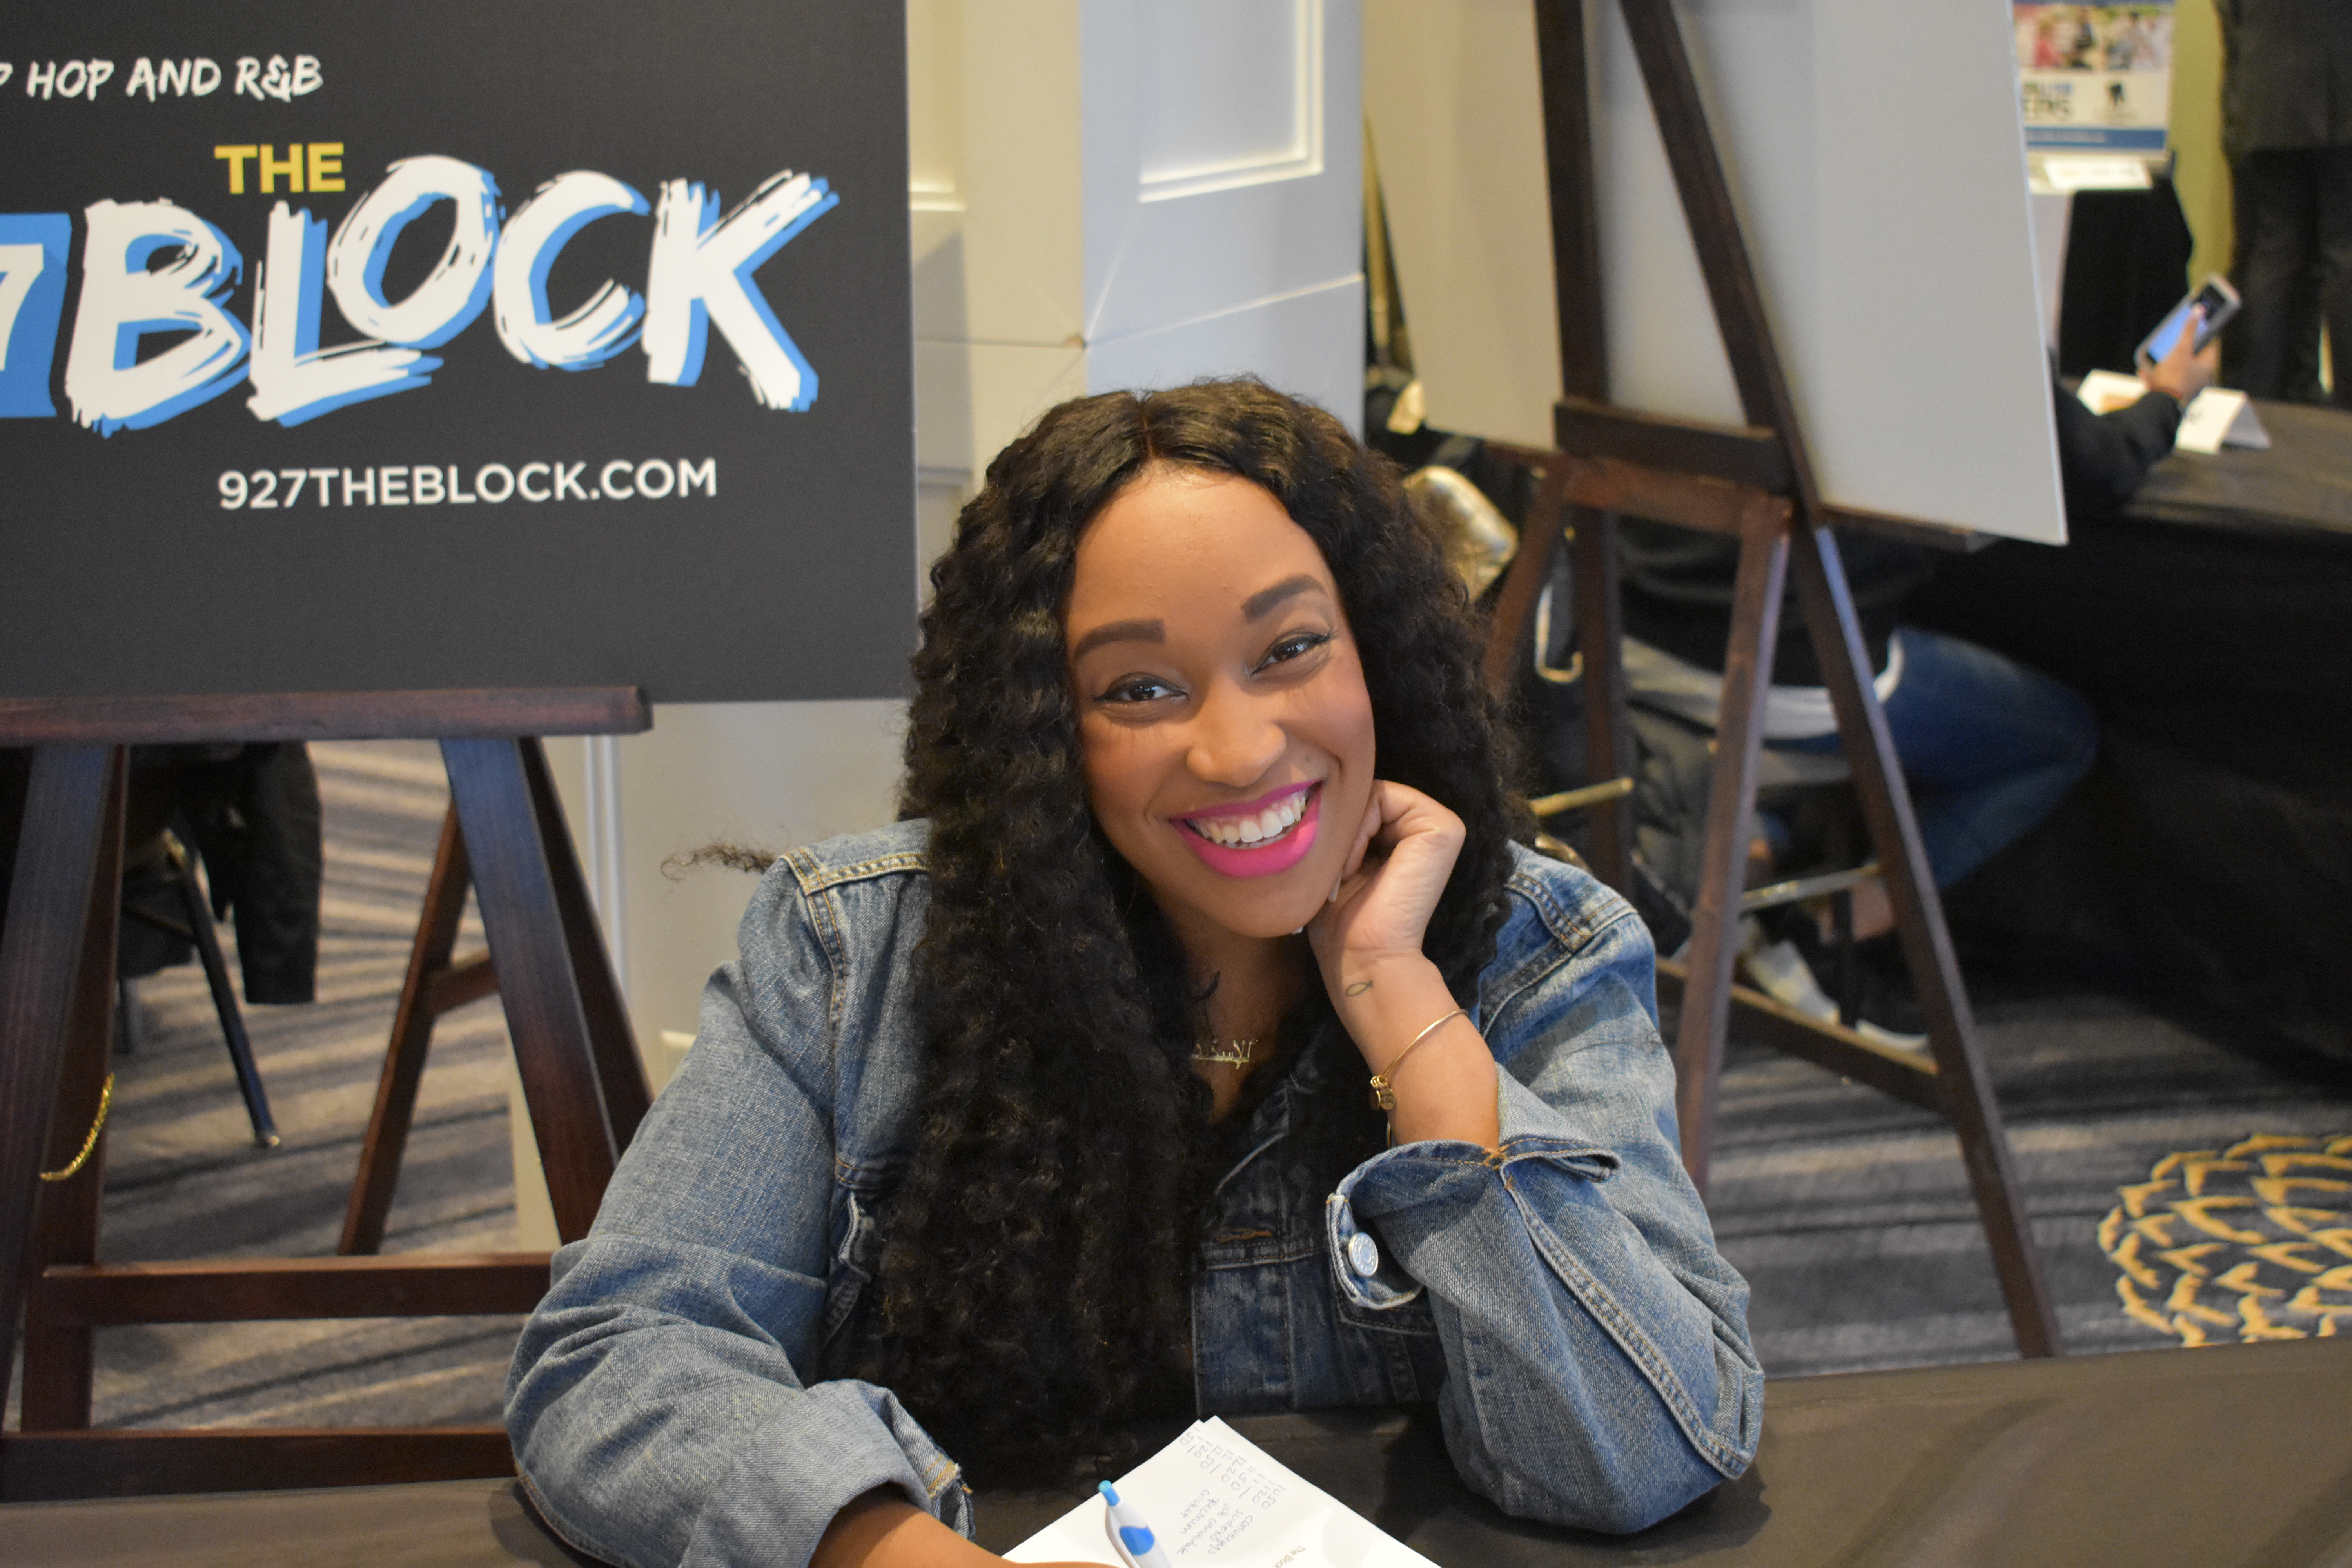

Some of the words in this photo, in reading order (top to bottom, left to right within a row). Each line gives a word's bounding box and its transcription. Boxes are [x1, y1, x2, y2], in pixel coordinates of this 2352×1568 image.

[26, 58, 115, 101] HOP
[125, 57, 222, 102] AND
[234, 54, 324, 102] R&B
[214, 142, 346, 194] THE
[65, 154, 840, 437] BLOCK
[218, 457, 717, 510] 927THEBLOCK.COM
[1252, 1480, 1274, 1503] 1120
[1290, 1545, 1306, 1555] The
